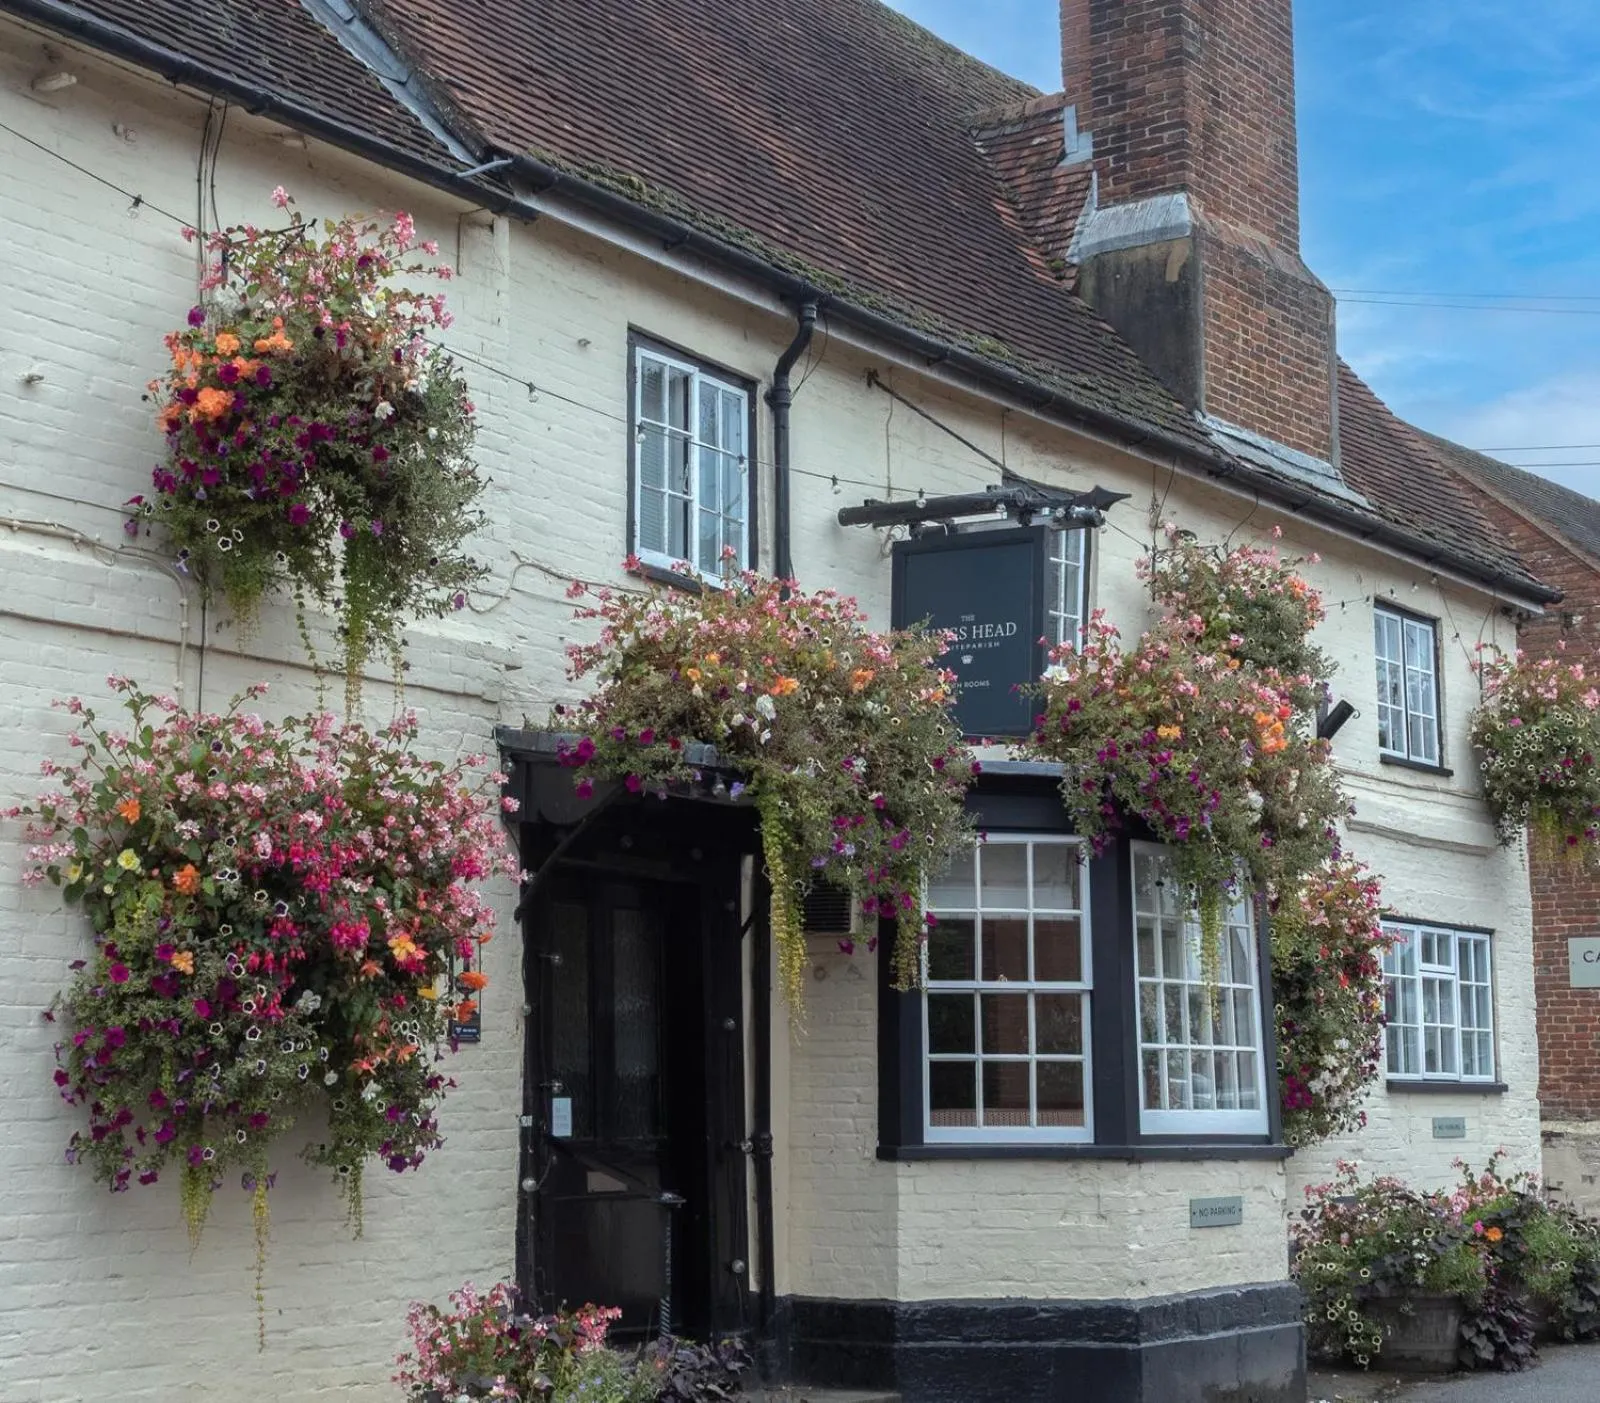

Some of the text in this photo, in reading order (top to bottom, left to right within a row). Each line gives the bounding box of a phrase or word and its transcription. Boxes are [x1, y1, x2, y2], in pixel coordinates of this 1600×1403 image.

[961, 614, 975, 622] THE
[972, 621, 1017, 639] HEAD
[948, 641, 1000, 651] ITEPARISH
[964, 680, 990, 688] ROOMS
[1199, 1205, 1235, 1216] NO PARKING
